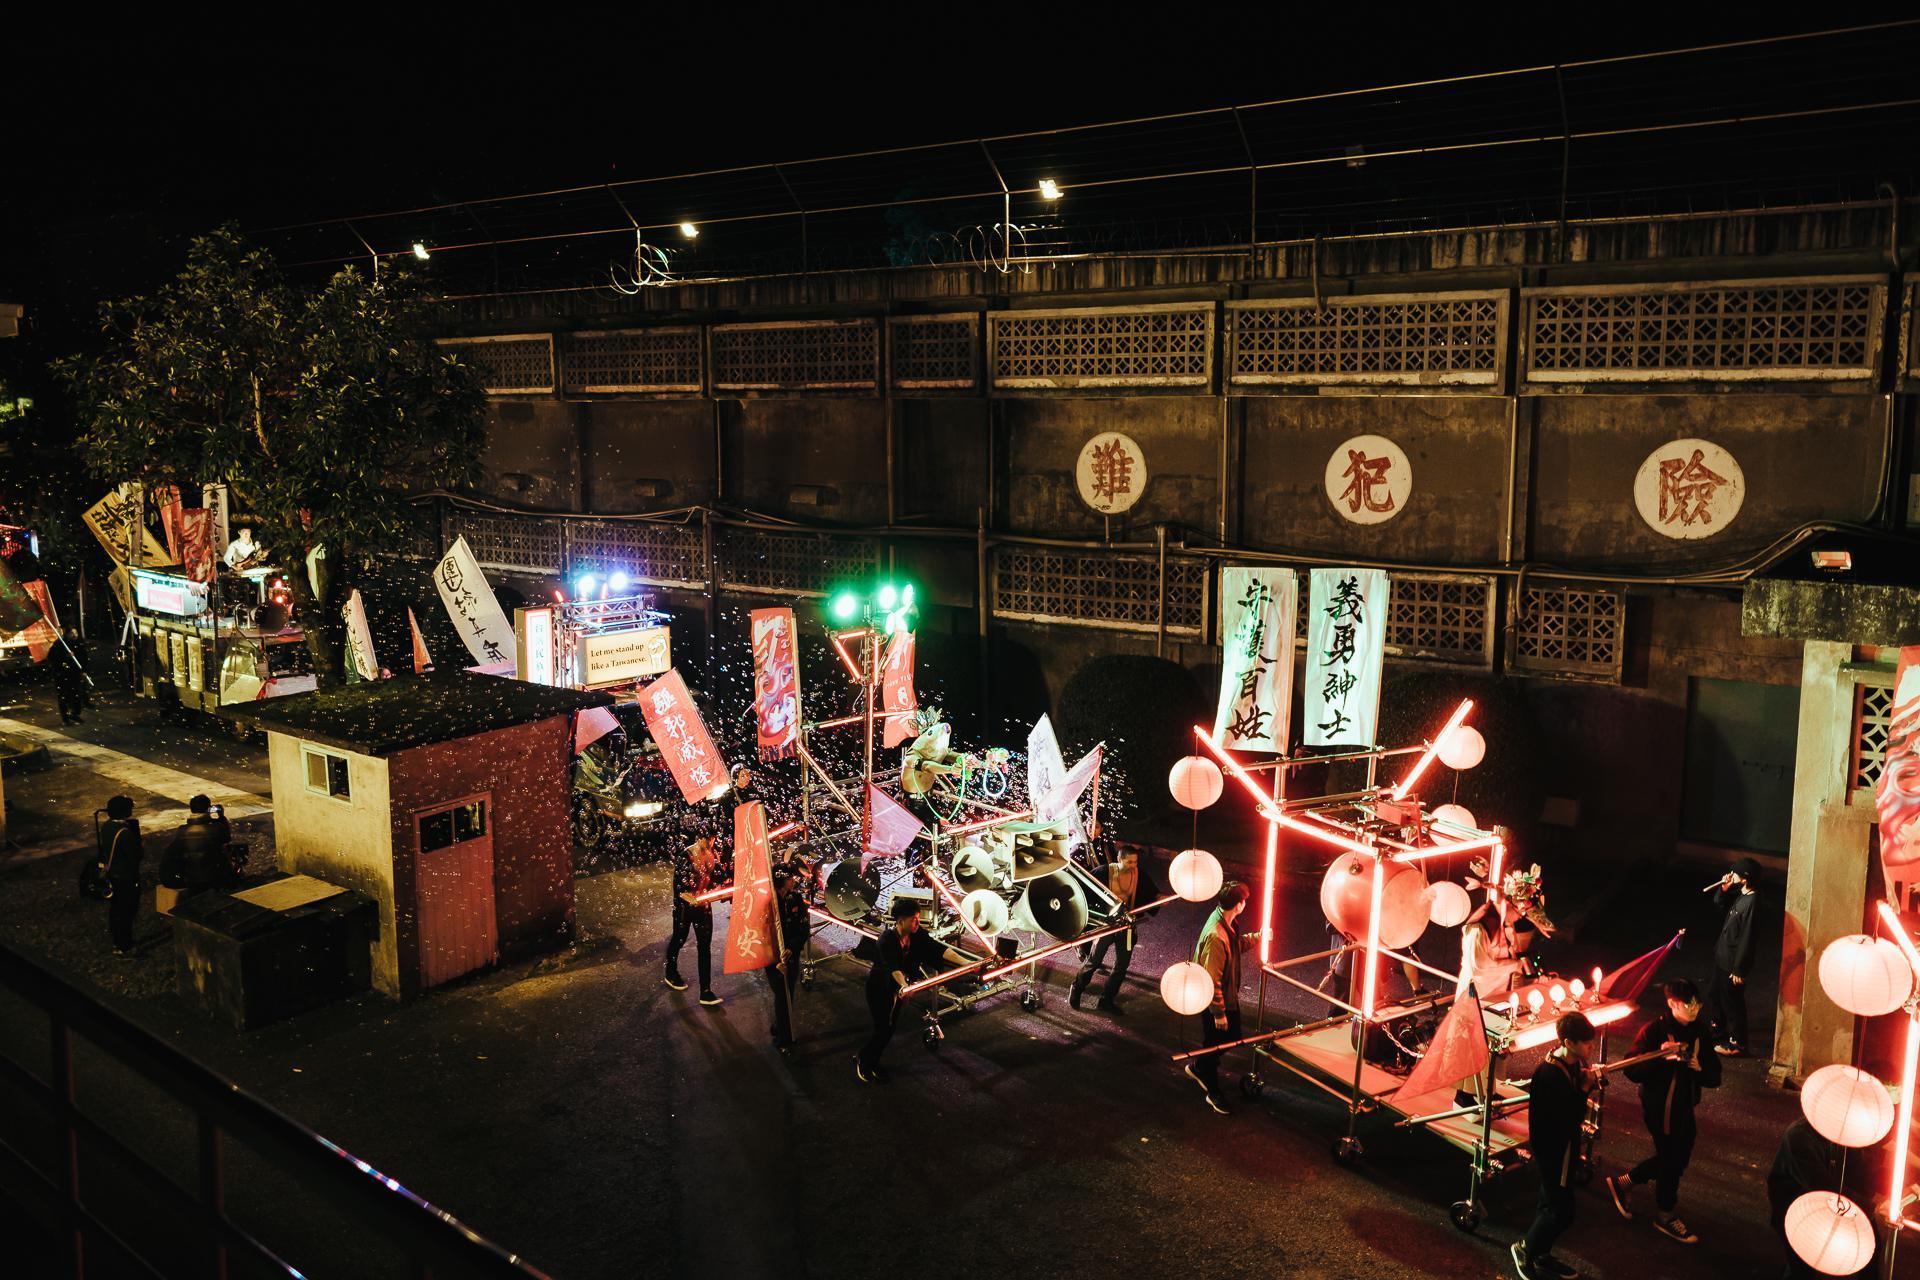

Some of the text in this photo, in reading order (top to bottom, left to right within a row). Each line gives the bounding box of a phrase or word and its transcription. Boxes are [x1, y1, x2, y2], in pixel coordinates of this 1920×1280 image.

[1090, 437, 1135, 504] 難
[1339, 449, 1395, 514] 犯
[1658, 448, 1729, 526] 險
[590, 643, 644, 658] Let me stand up
[591, 662, 605, 671] like
[1317, 575, 1365, 740] 義勇紳士
[651, 686, 712, 790] 驅邪滅怪
